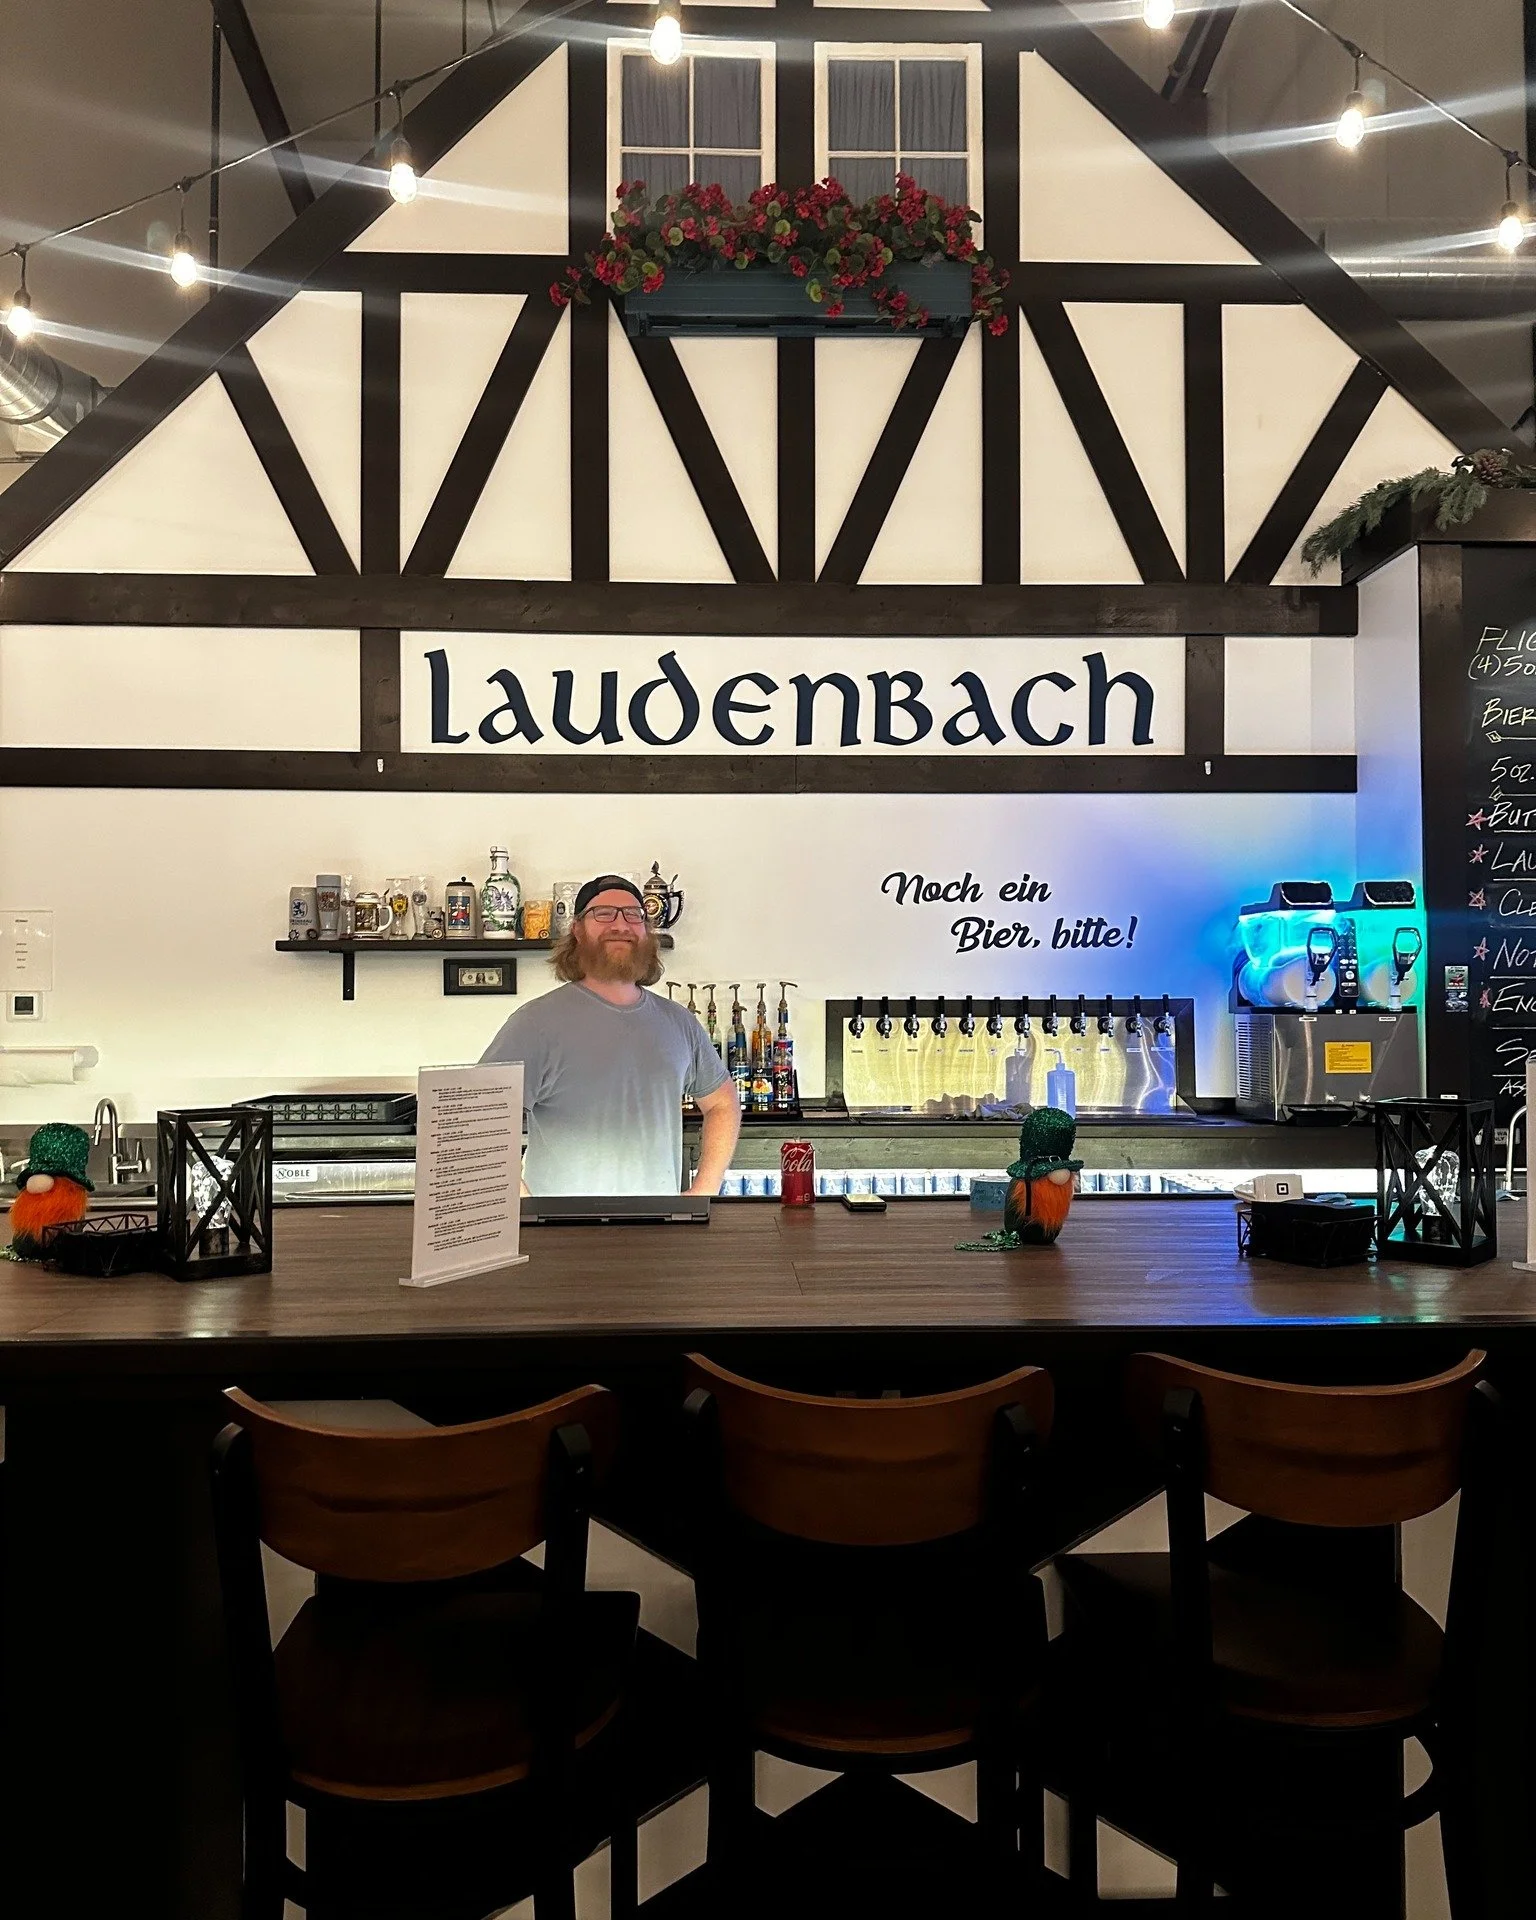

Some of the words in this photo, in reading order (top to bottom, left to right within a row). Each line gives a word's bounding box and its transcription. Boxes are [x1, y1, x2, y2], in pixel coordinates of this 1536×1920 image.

[881, 872, 983, 906] Noch
[999, 873, 1052, 903] ein
[951, 916, 1041, 954] Bier,
[1051, 915, 1138, 950] bitte!
[277, 1168, 311, 1179] NOBLE
[782, 1147, 814, 1173] Cola
